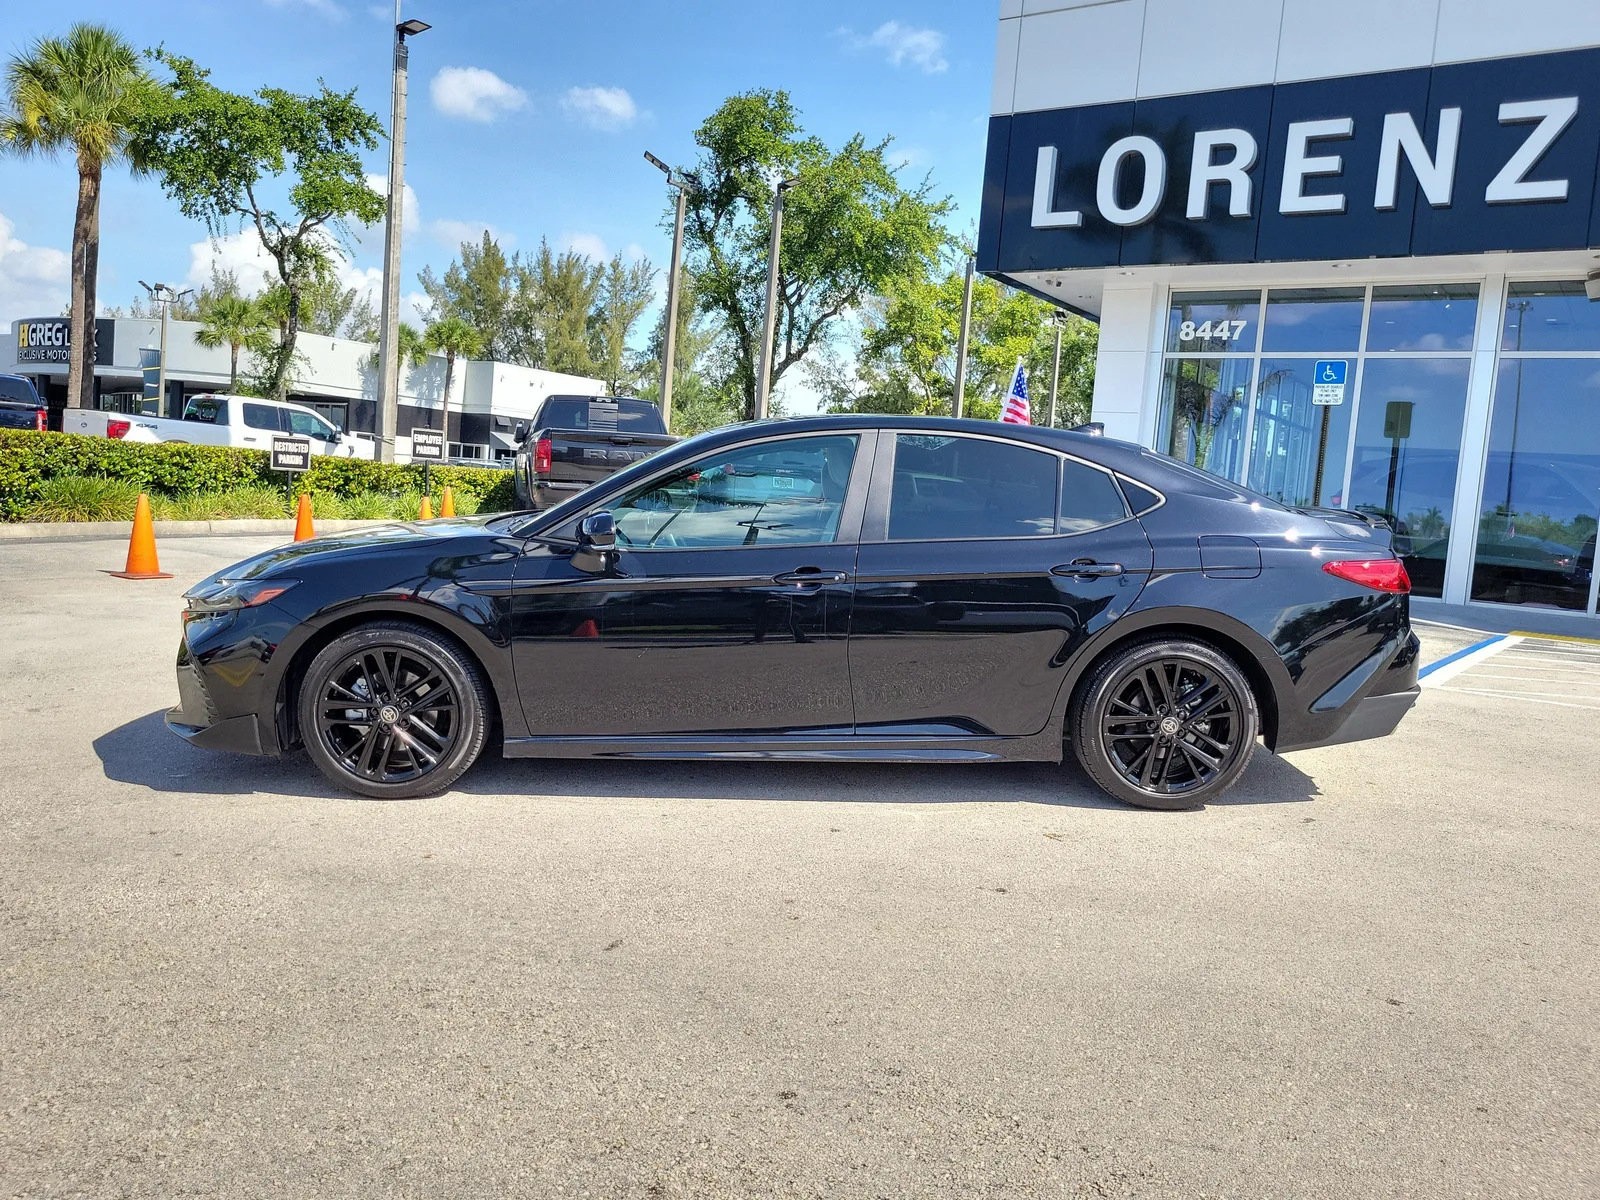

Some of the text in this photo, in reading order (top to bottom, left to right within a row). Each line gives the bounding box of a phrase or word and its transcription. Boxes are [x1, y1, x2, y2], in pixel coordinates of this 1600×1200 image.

[1030, 96, 1579, 229] LORENZ
[1179, 320, 1247, 341] 8447
[19, 349, 45, 360] EXCLUSIVE
[413, 433, 443, 445] EMPLOYEE
[274, 440, 309, 453] RESTRICTED
[415, 444, 440, 456] PARKING
[277, 453, 304, 465] PARKING
